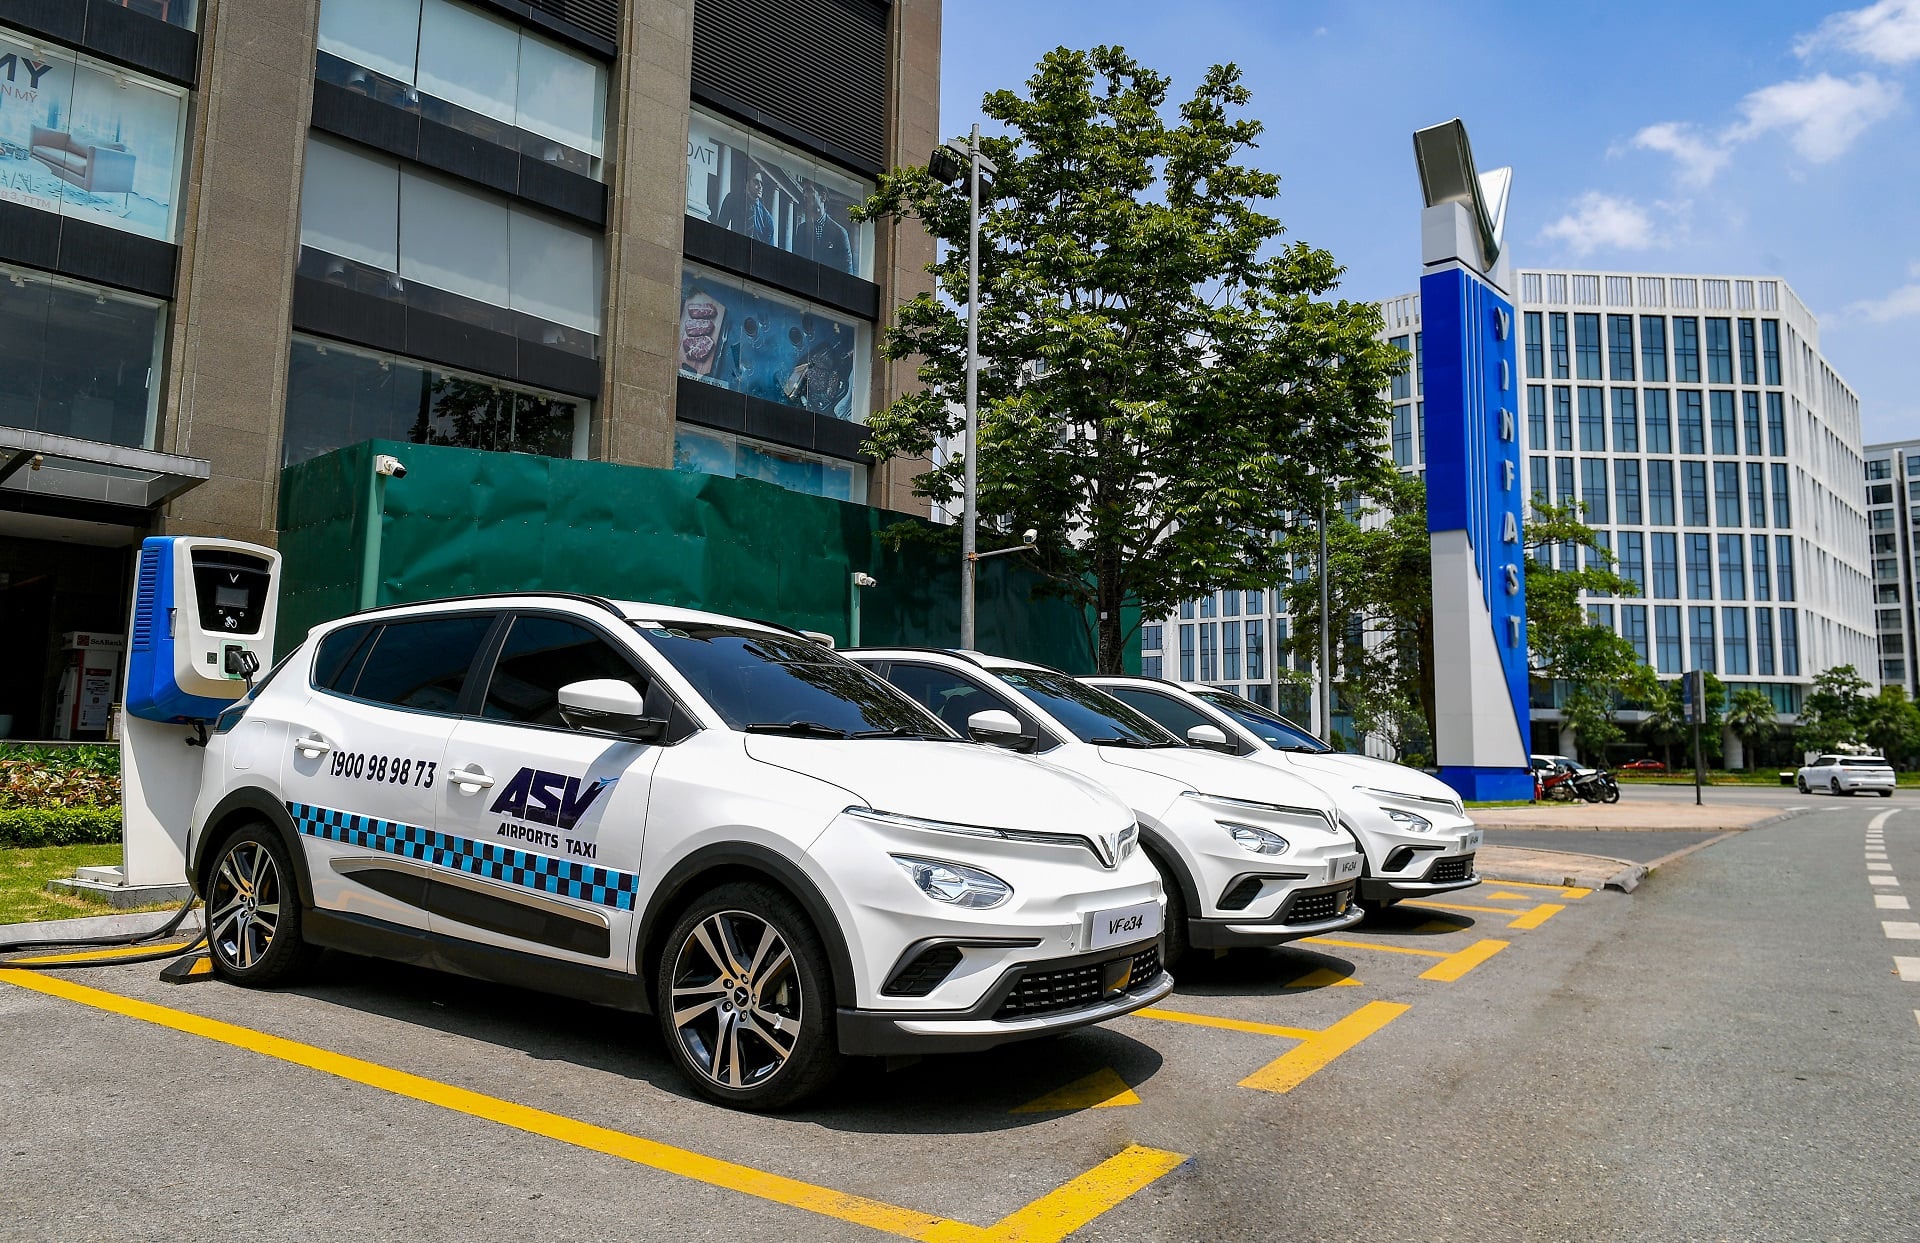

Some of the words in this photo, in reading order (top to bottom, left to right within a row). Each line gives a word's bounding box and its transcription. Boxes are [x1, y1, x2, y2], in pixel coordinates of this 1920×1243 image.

[1494, 305, 1520, 649] VINFAST
[90, 638, 122, 647] SeABank
[330, 750, 365, 779] 1900
[366, 754, 388, 782] 98
[388, 757, 411, 785] 98
[413, 760, 437, 788] 73
[489, 766, 607, 831] ASV
[496, 822, 559, 849] AIRPORTS
[565, 838, 597, 859] TAXI
[1109, 914, 1143, 935] VFe34
